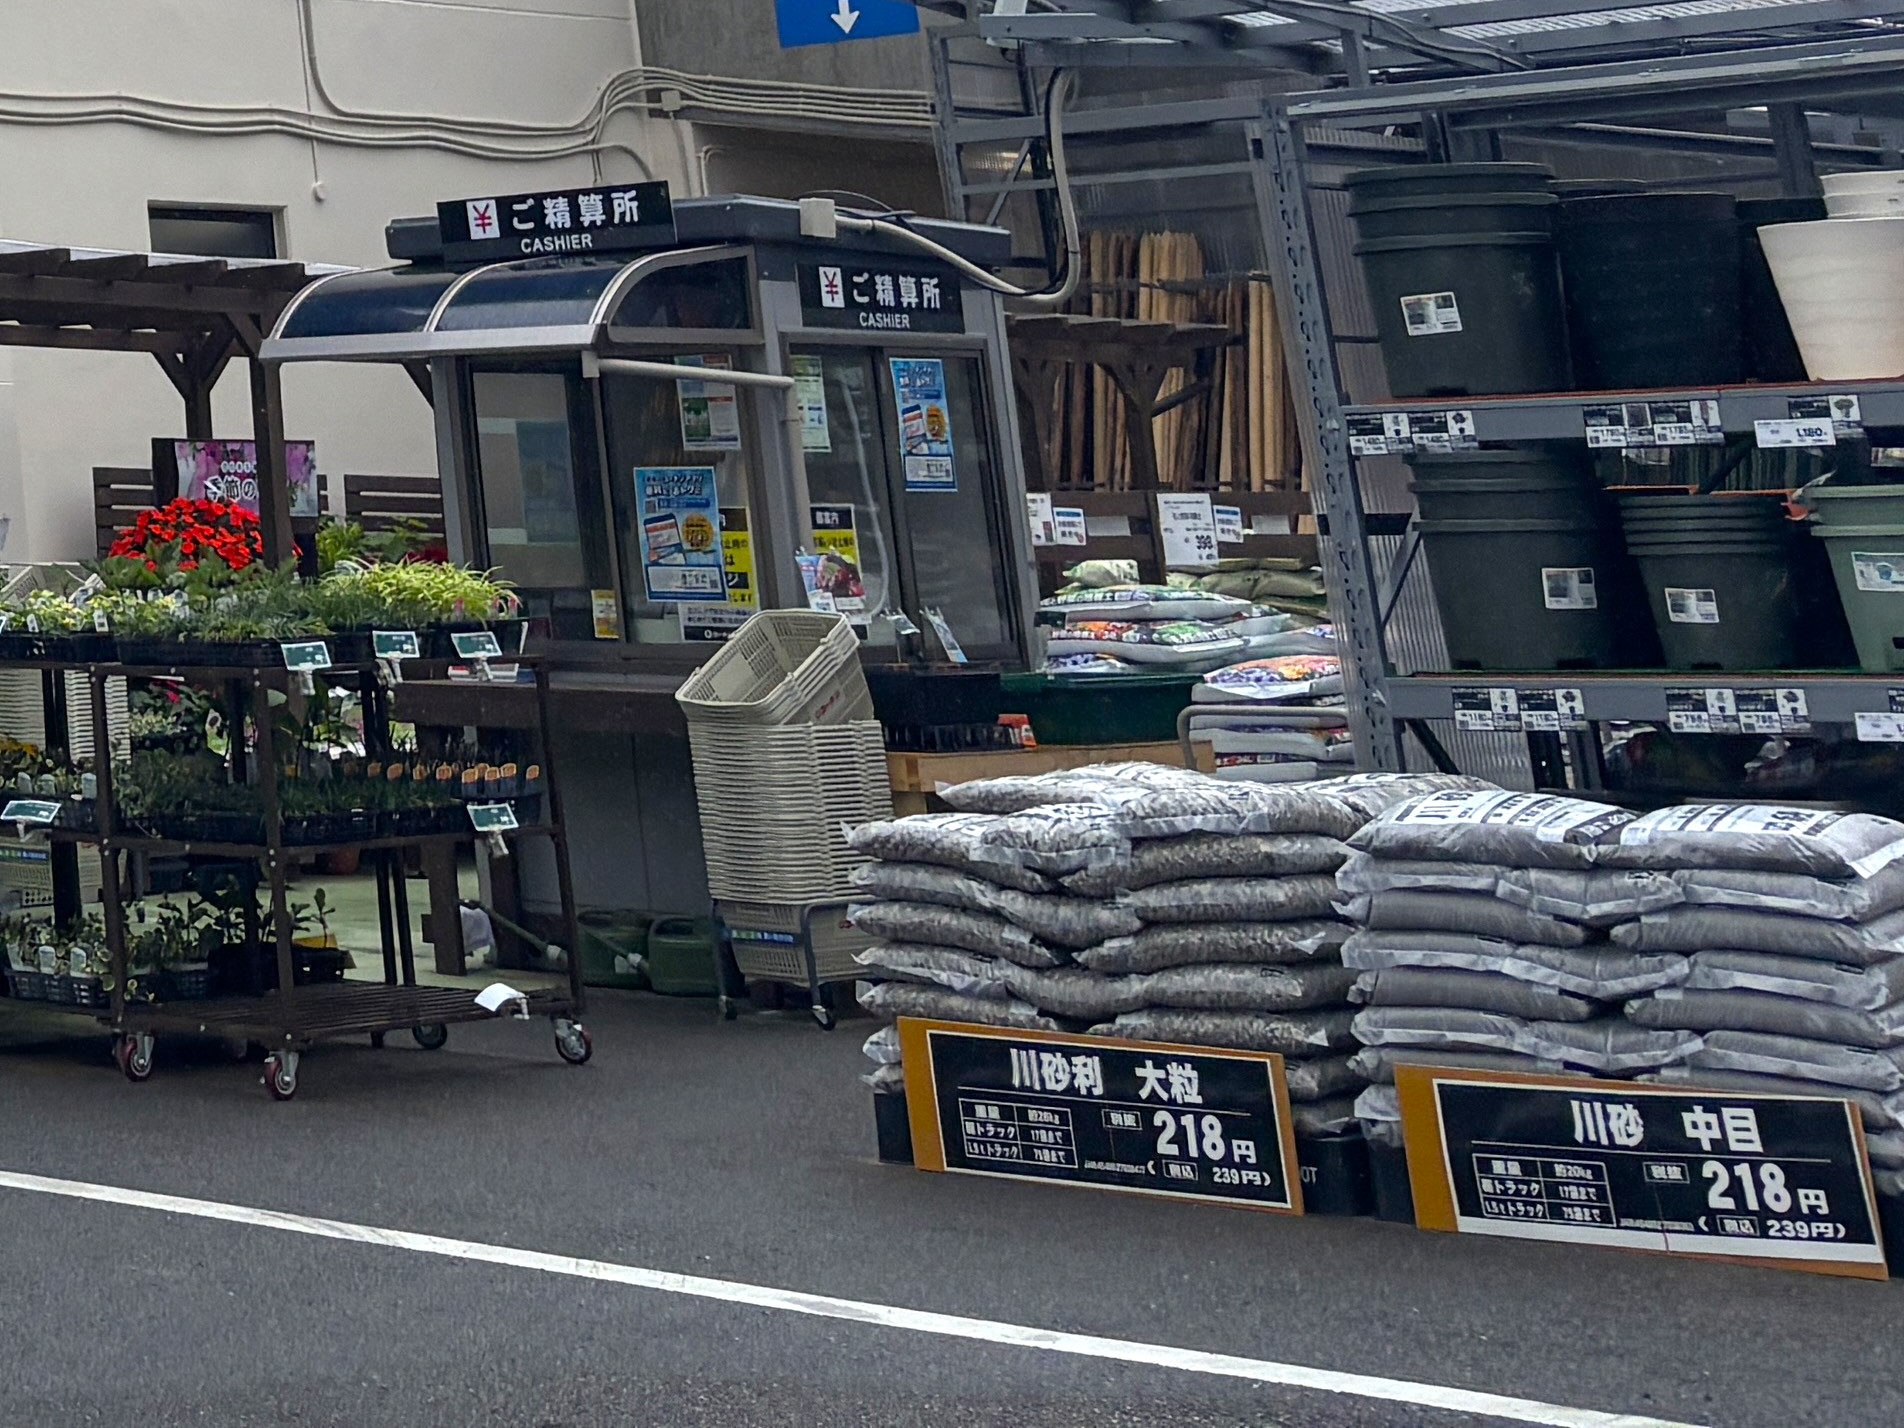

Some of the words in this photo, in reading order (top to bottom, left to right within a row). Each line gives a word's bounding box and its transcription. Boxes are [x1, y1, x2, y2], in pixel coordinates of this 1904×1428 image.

[512, 189, 639, 230] ご精算所
[520, 233, 593, 253] CASHIER
[853, 272, 941, 309] ご精算所
[859, 312, 911, 329] CASHIER
[1010, 1048, 1103, 1096] 川砂利
[1135, 1060, 1203, 1104] 大粒
[1570, 1099, 1644, 1146] 川砂
[1682, 1105, 1764, 1153] 中目
